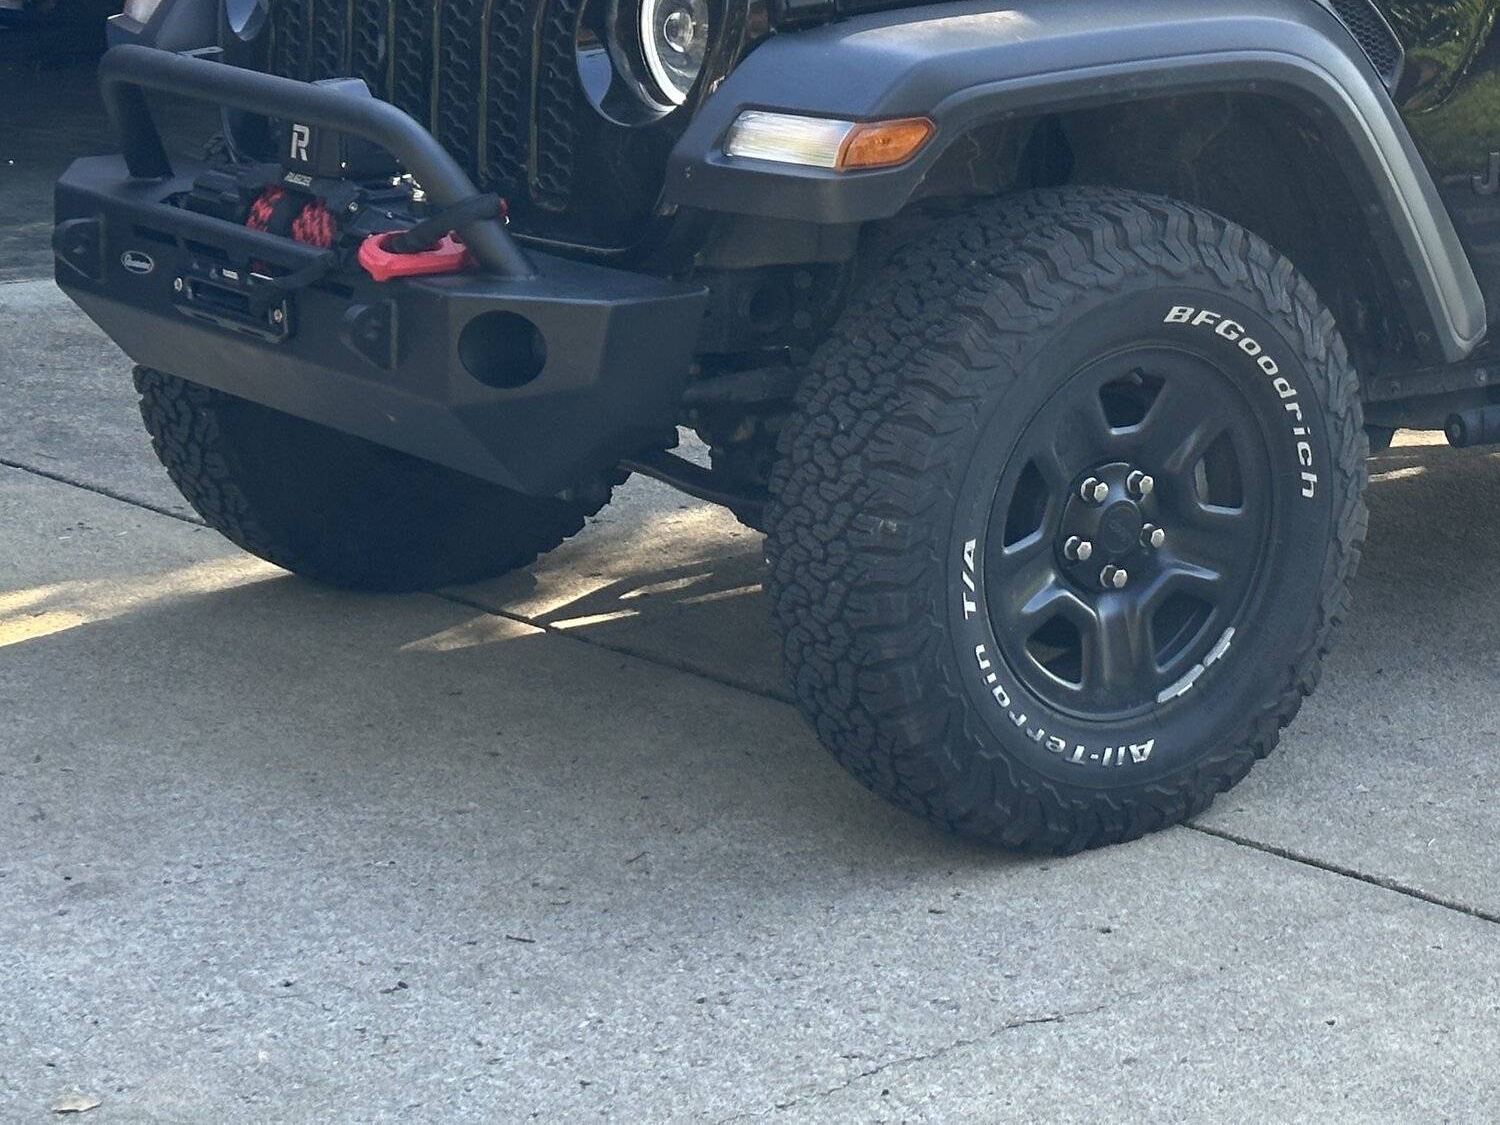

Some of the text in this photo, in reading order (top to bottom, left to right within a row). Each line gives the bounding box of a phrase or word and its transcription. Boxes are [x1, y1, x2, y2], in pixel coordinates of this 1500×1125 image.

[291, 123, 310, 162] R
[1163, 306, 1318, 498] BFGoodrich
[962, 538, 1155, 767] All-Terrain T/A
